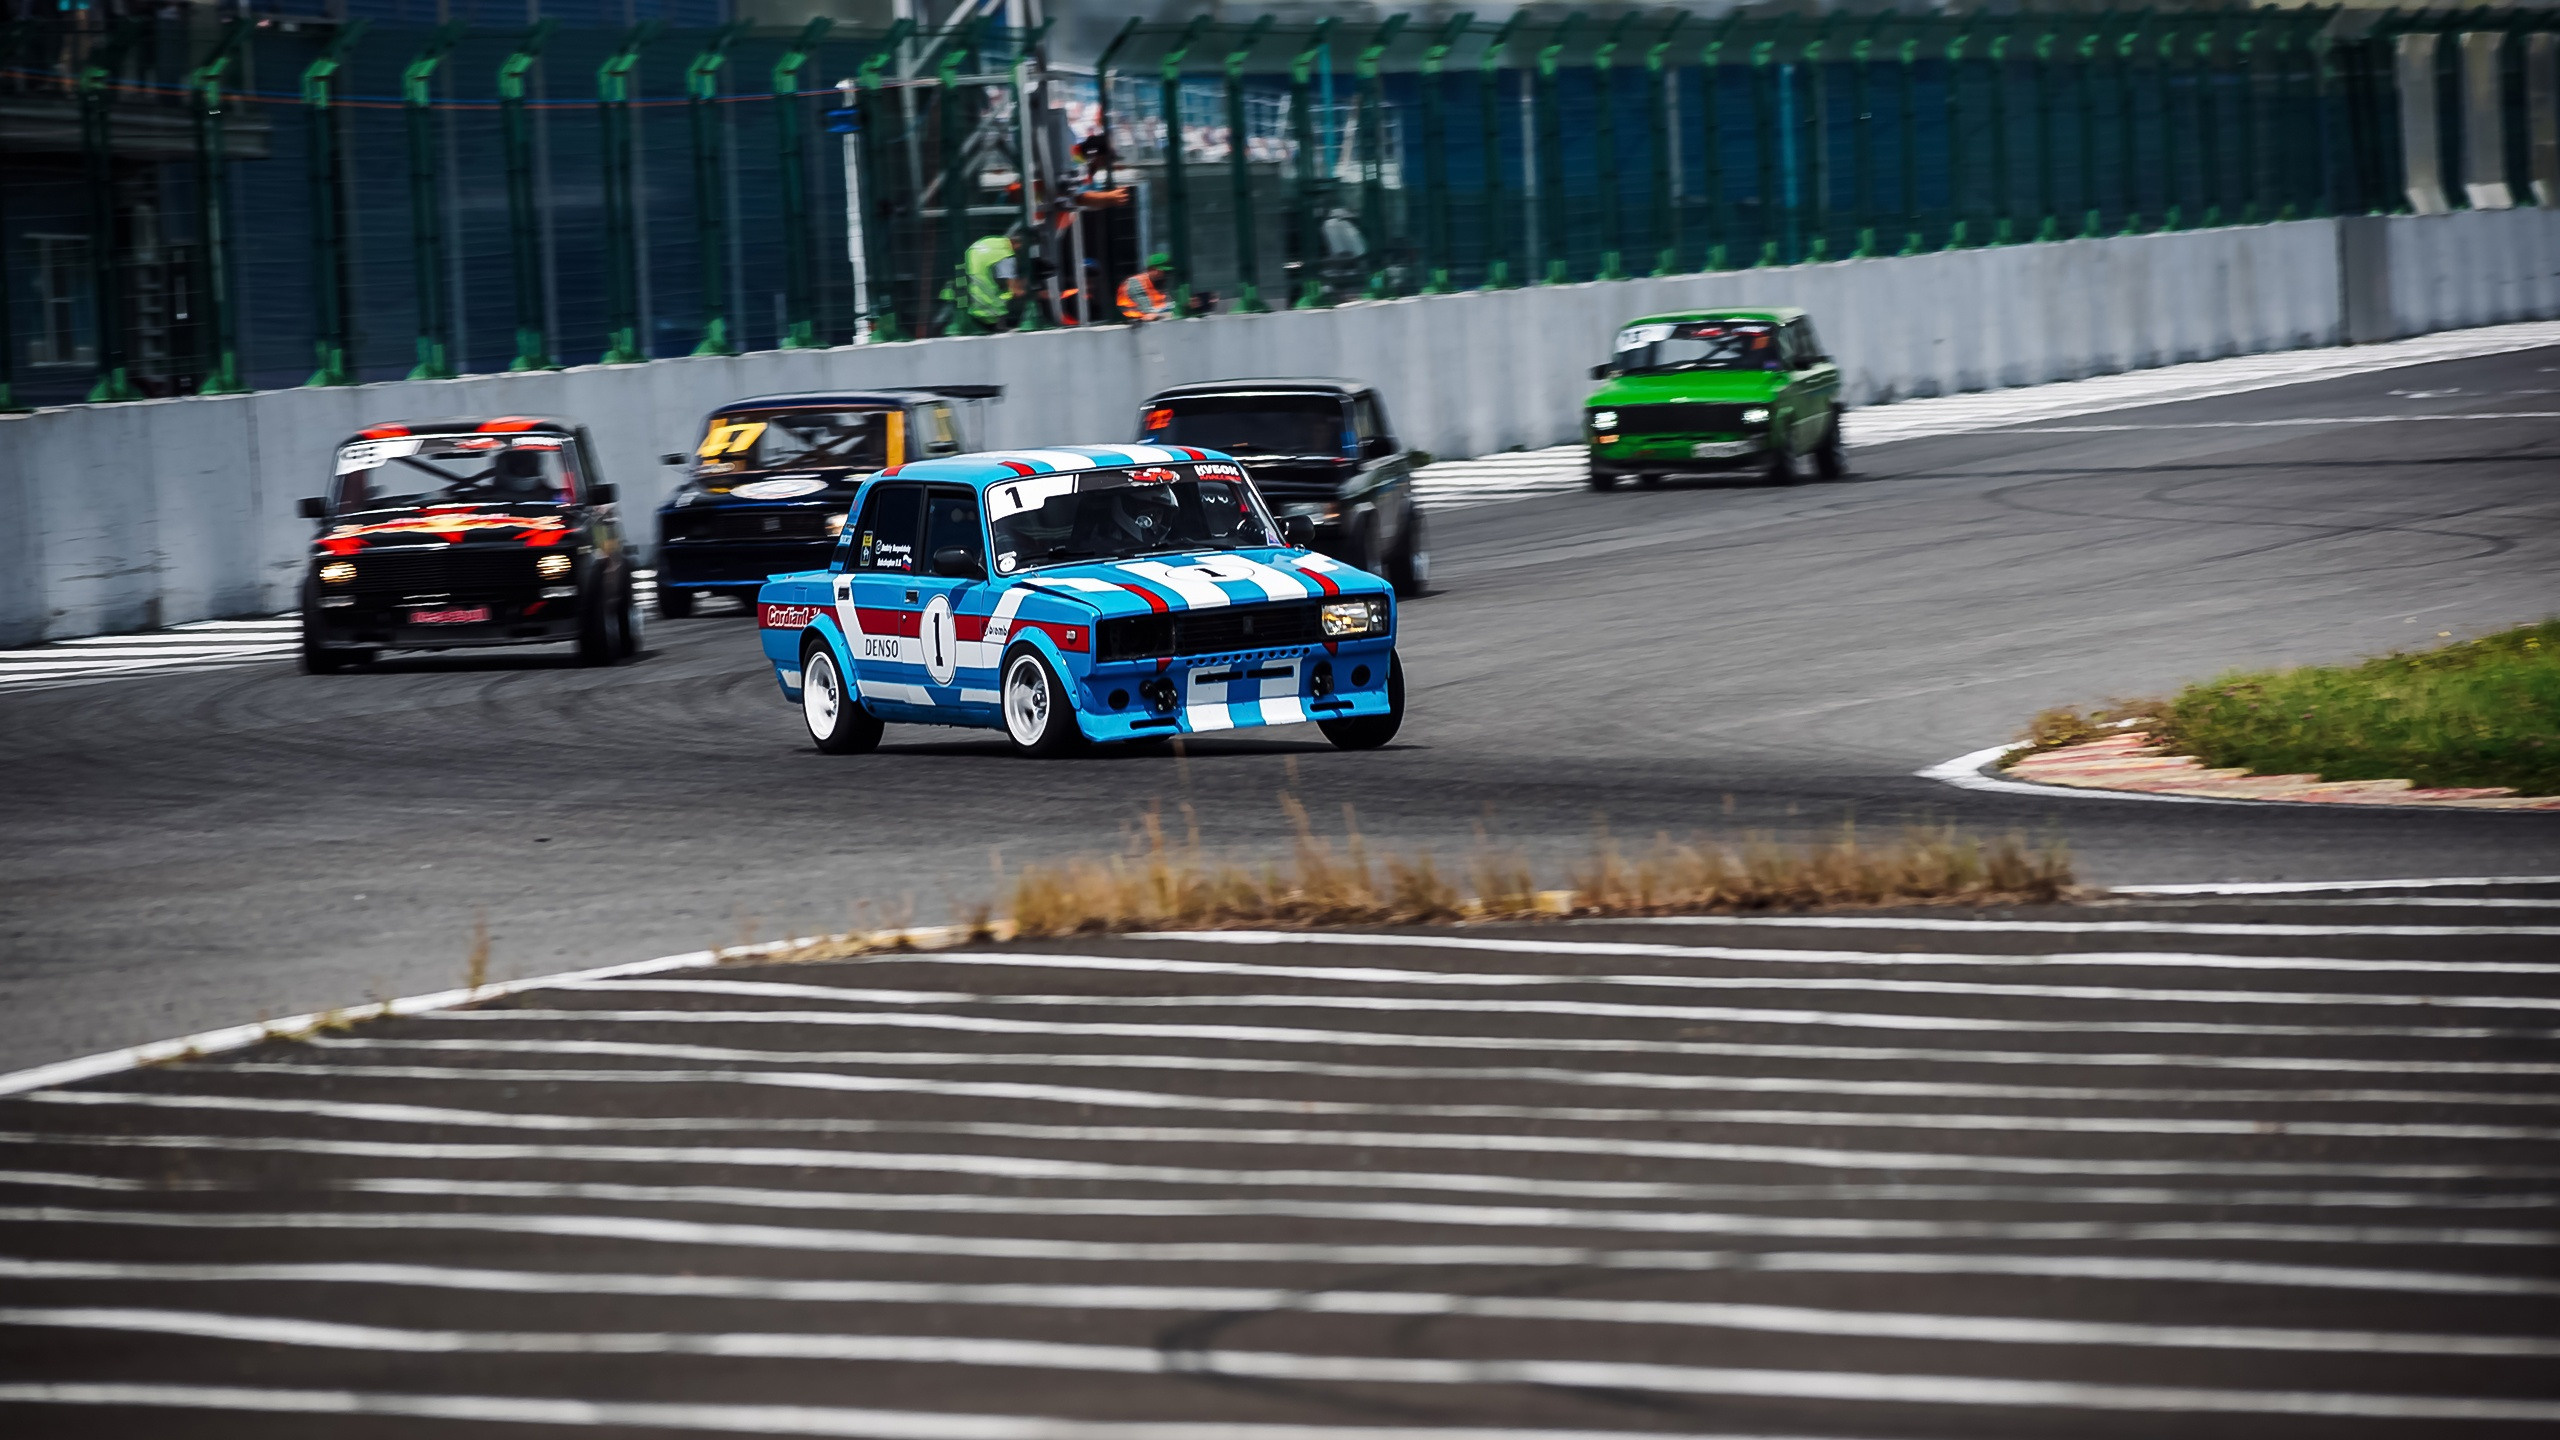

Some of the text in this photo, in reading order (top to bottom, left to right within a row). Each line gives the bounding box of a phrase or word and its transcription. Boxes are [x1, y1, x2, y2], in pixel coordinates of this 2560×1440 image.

[1193, 465, 1240, 477] КУБОК
[1004, 486, 1023, 509] 1
[1193, 568, 1227, 578] 1
[767, 605, 809, 628] Cordiant
[865, 639, 899, 659] DENSO
[933, 612, 944, 667] 1
